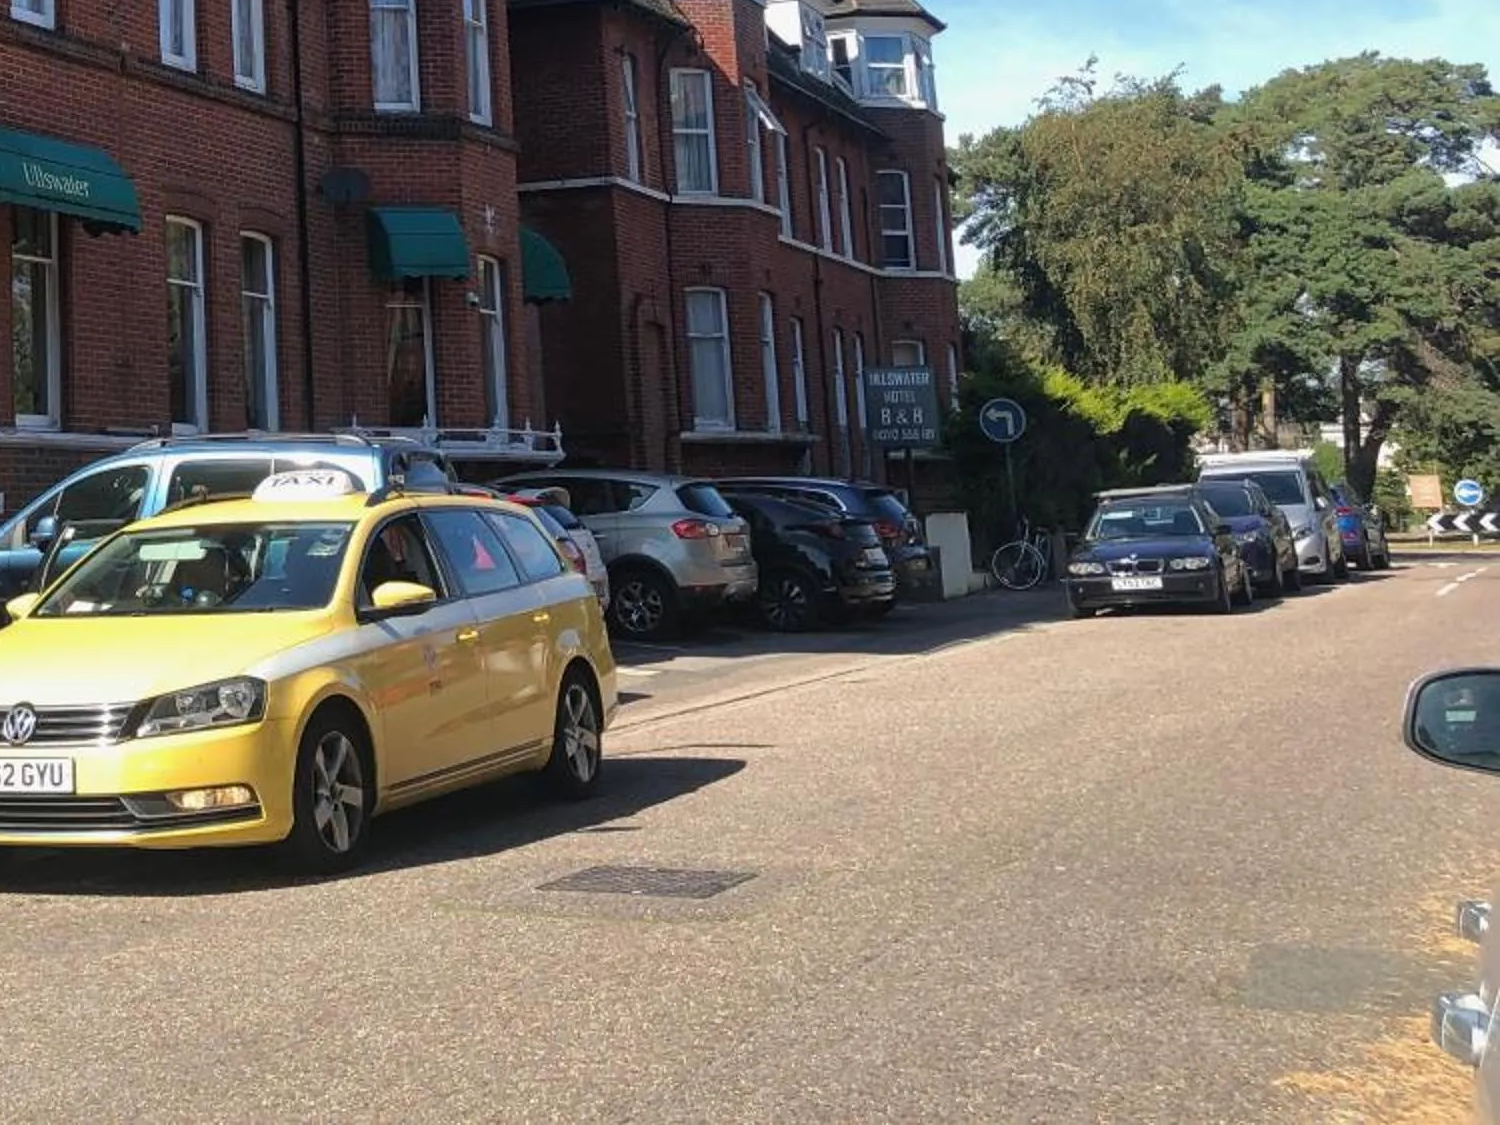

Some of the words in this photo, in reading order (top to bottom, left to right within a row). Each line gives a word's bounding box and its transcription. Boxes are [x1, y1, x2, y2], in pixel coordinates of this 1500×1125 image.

[22, 161, 91, 198] Ullswater
[868, 371, 929, 386] ULLSWATER
[881, 407, 891, 425] B
[896, 409, 908, 425] &
[913, 407, 923, 424] B
[271, 475, 336, 488] TAXI
[21, 762, 64, 787] GYU
